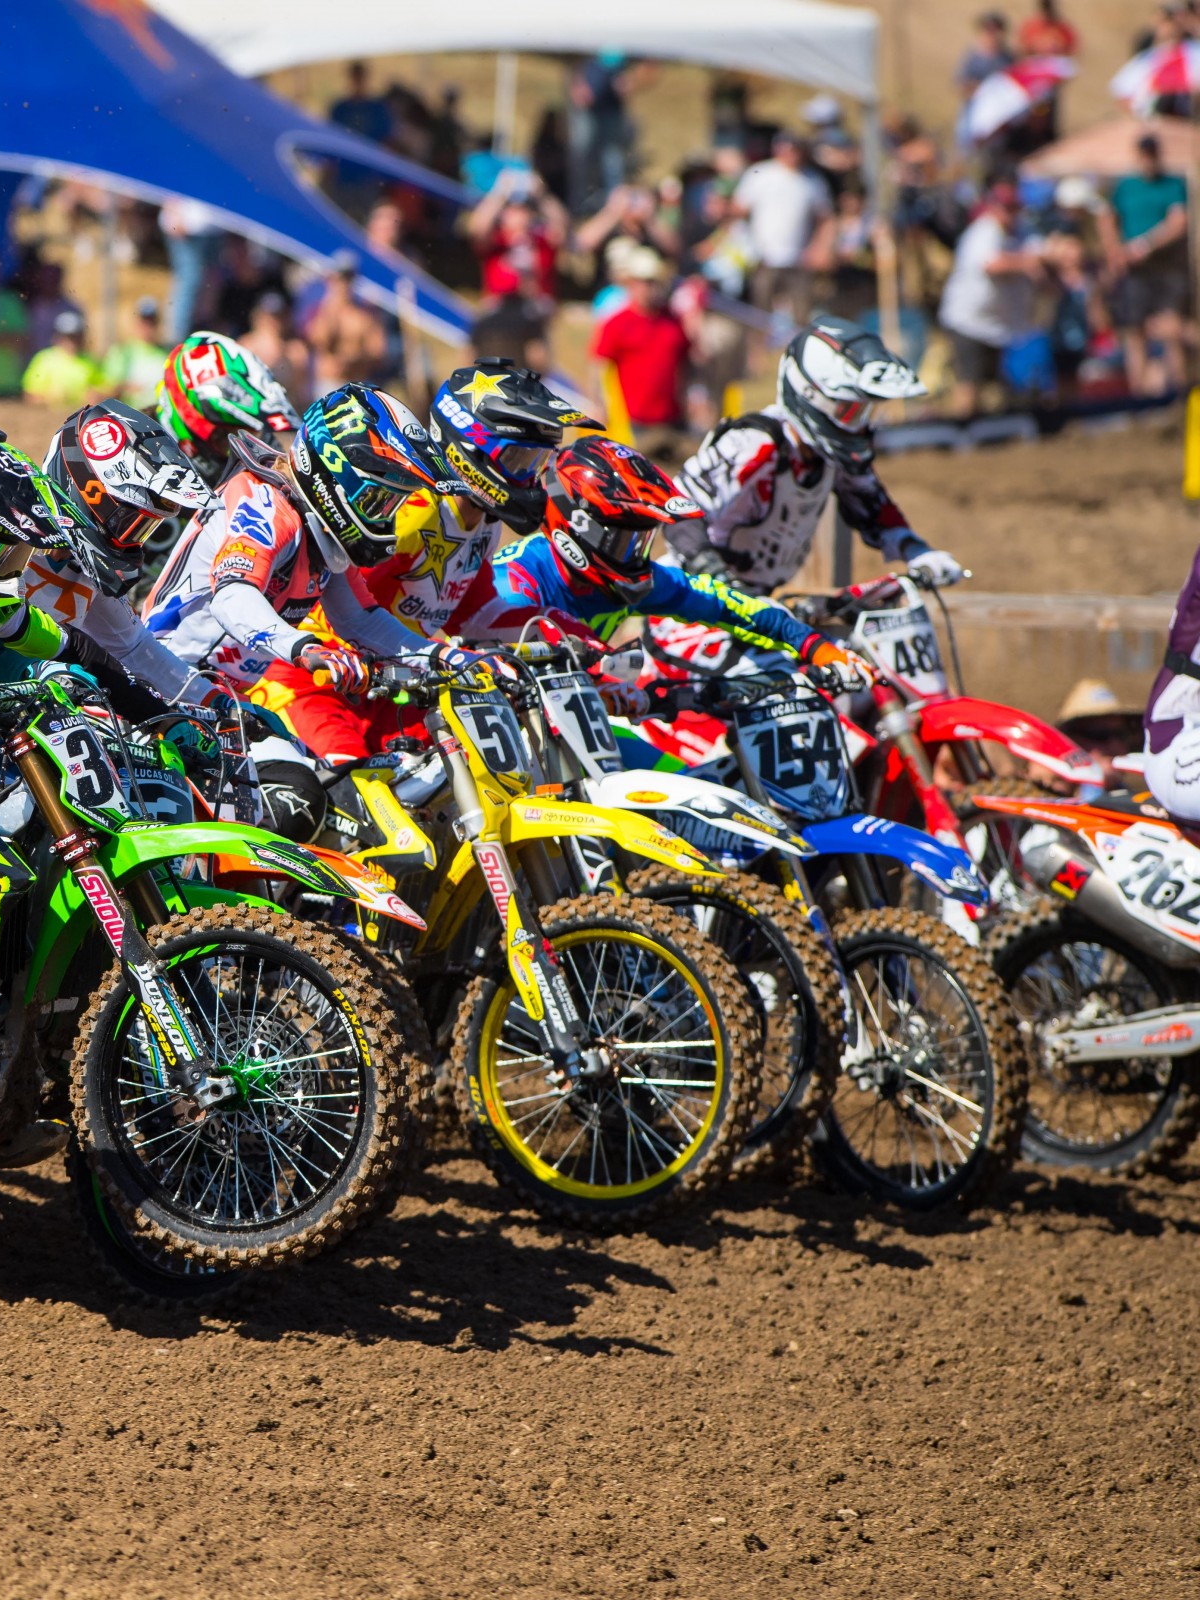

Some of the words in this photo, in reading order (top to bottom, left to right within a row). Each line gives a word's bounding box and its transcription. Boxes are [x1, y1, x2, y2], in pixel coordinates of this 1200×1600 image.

[437, 393, 493, 447] 100%
[446, 442, 510, 507] ROCKSTAR
[554, 530, 586, 565] Arai
[563, 692, 618, 754] 15
[766, 703, 796, 718] LUCAS
[752, 718, 843, 790] 154
[71, 798, 110, 828] Kawasaki
[558, 813, 596, 825] TOYOTA
[674, 815, 744, 851] YAMAHA
[1117, 850, 1200, 927] 262
[134, 964, 194, 1063] DUNLOP
[331, 987, 372, 1067] DUNLOP
[529, 961, 568, 1034] DUNLOP
[140, 1001, 178, 1067] ACERBIS
